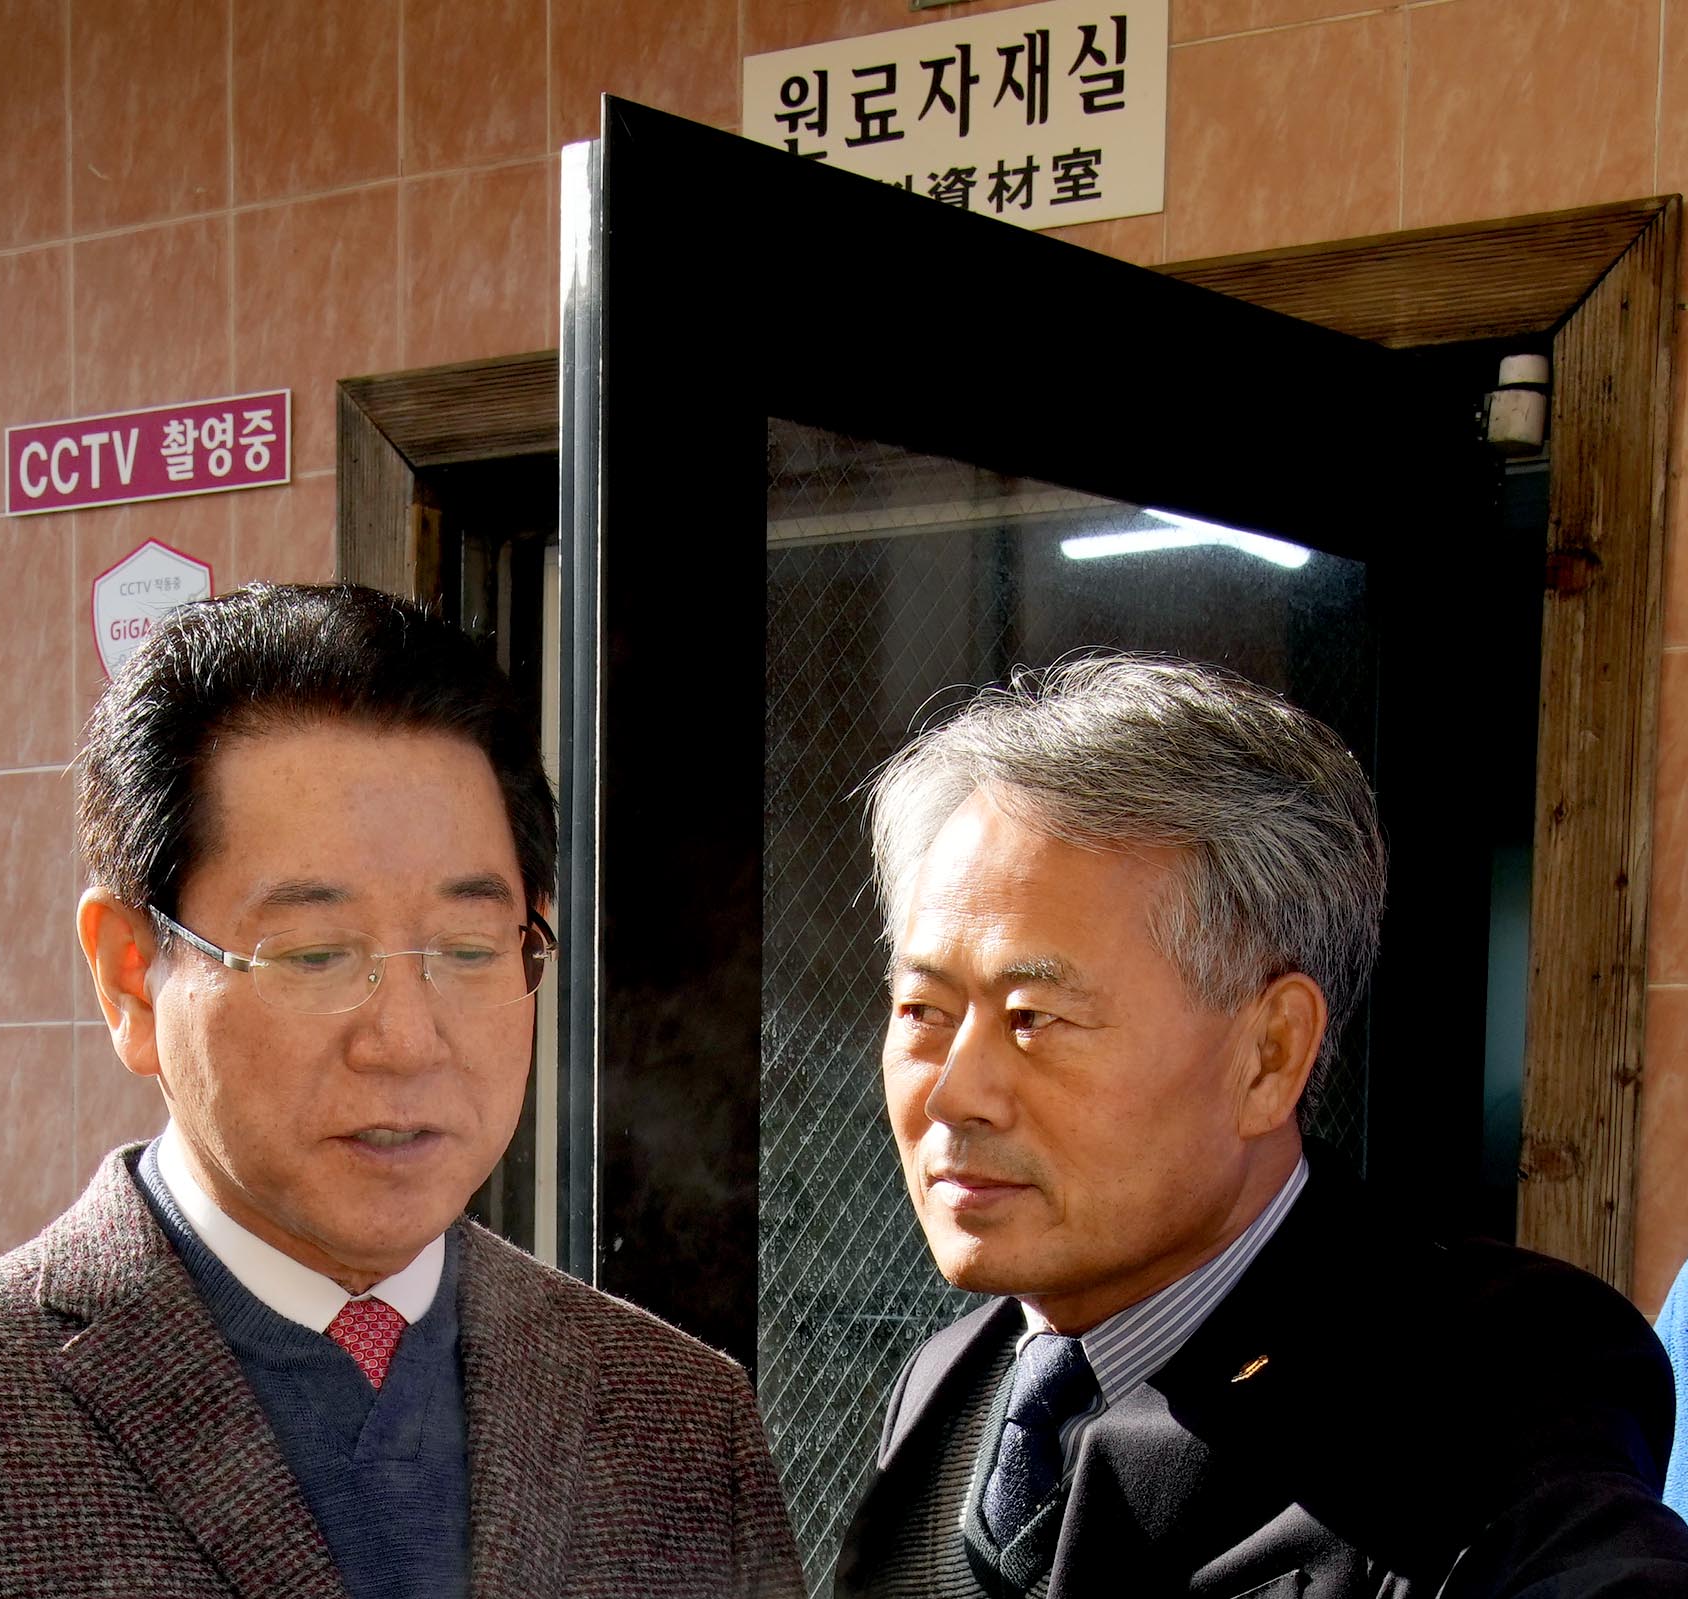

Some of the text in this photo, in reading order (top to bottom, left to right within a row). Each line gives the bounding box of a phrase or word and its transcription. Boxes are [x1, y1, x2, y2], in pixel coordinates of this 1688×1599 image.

[774, 14, 1128, 161] 원료자재실
[878, 146, 1103, 215] 資材室
[19, 408, 277, 498] CCTV 촬영중
[119, 576, 182, 597] CCTV 작동중
